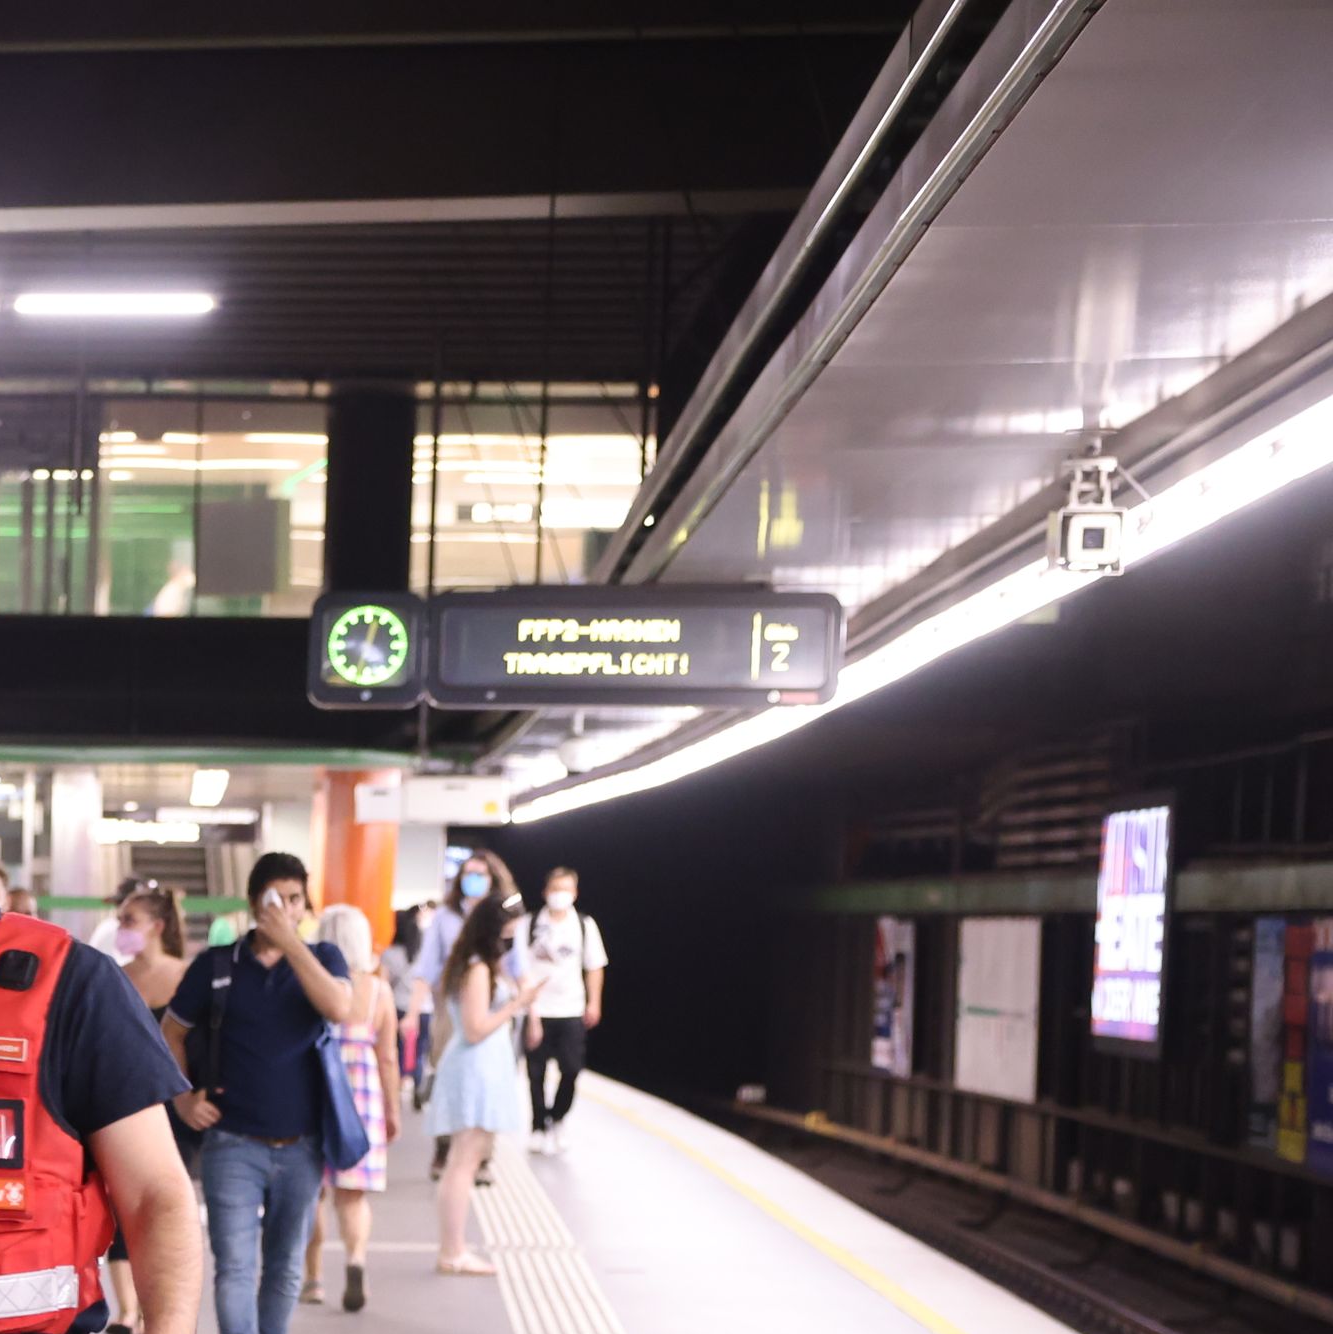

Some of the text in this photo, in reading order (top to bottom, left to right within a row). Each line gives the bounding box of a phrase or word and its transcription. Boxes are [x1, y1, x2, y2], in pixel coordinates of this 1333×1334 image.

[518, 619, 681, 643] FFP2-MASKEN
[503, 652, 690, 675] TRAGEPFLICHT!
[770, 642, 790, 672] 2
